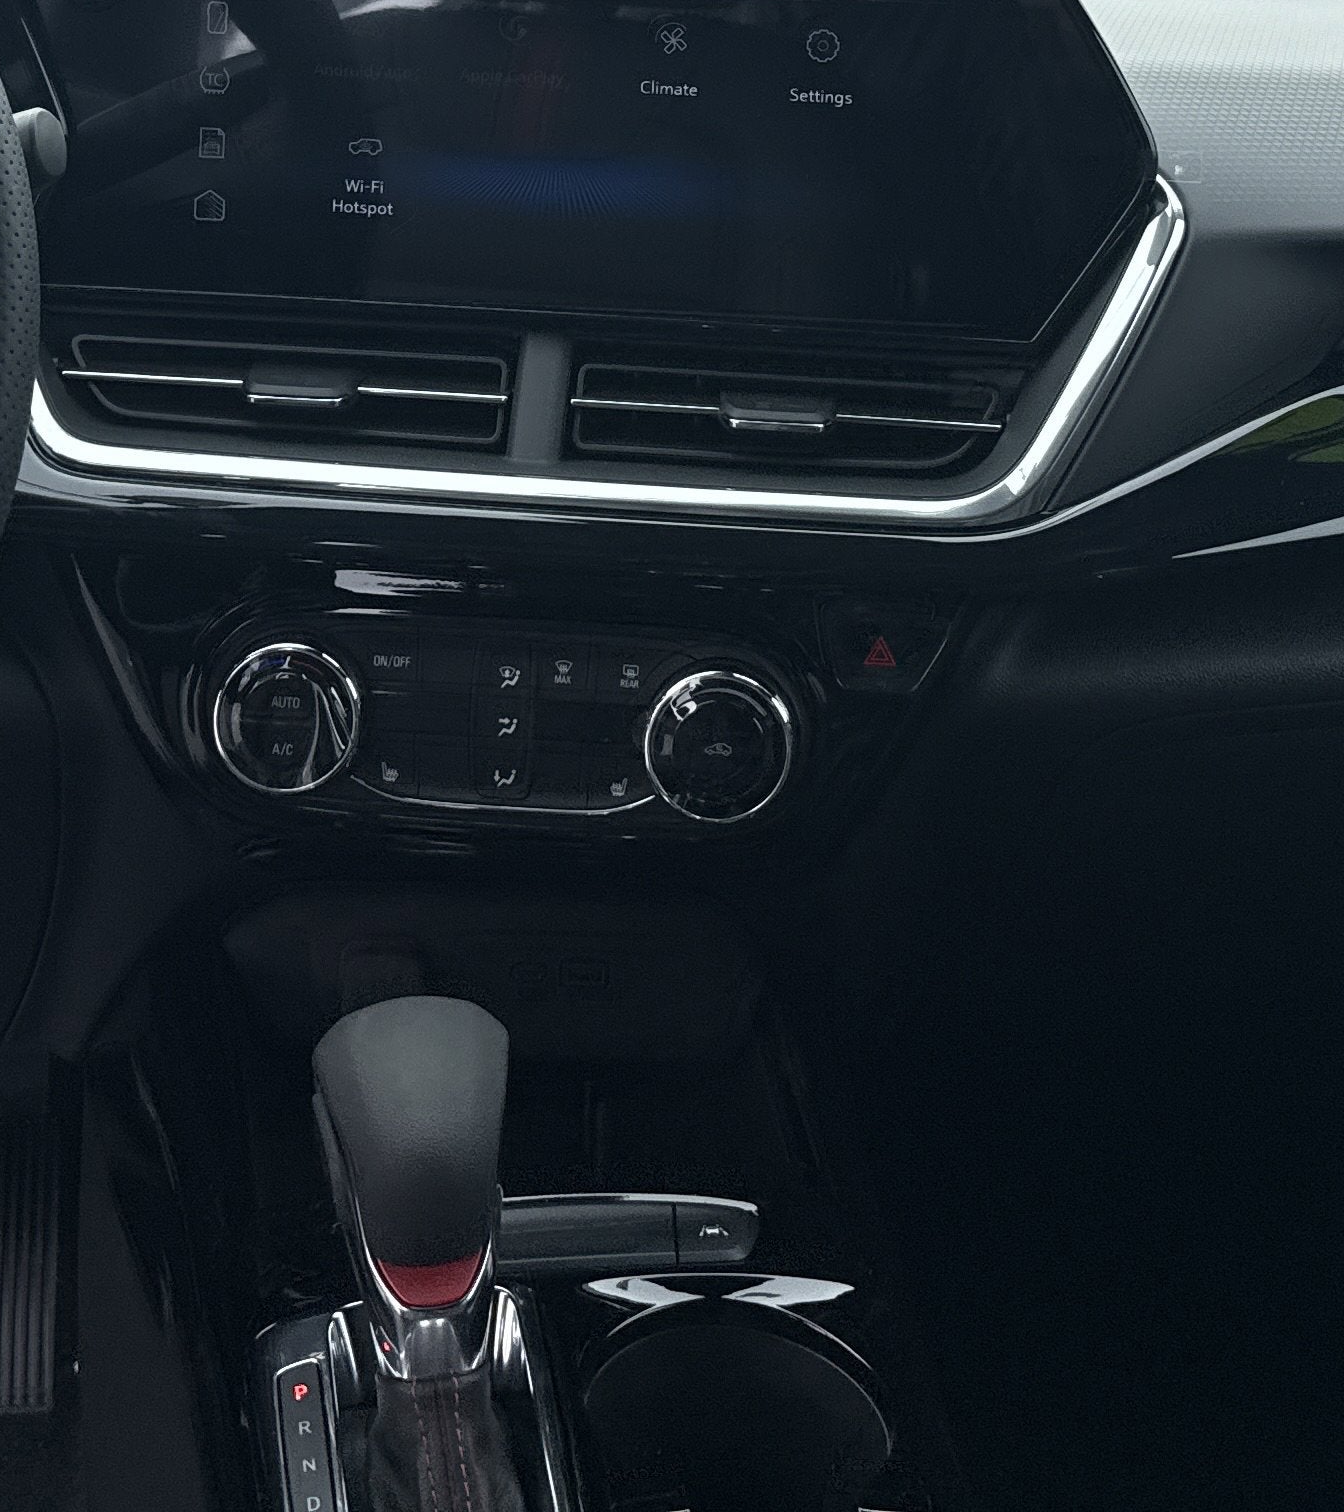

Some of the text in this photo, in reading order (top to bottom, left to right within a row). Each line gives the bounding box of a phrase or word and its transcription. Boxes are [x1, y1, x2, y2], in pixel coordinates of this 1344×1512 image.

[640, 80, 698, 97] Climate
[789, 88, 853, 108] Settings
[344, 178, 385, 194] Wi-Fi
[332, 199, 394, 218] Hotspot
[373, 655, 411, 670] ON/OFF
[554, 675, 572, 685] MAX
[619, 678, 640, 689] REAR
[271, 696, 301, 710] AUTO
[271, 742, 294, 757] A/C
[293, 1384, 308, 1401] P
[298, 1420, 313, 1435] R
[302, 1458, 316, 1473] N
[306, 1496, 321, 1512] D
